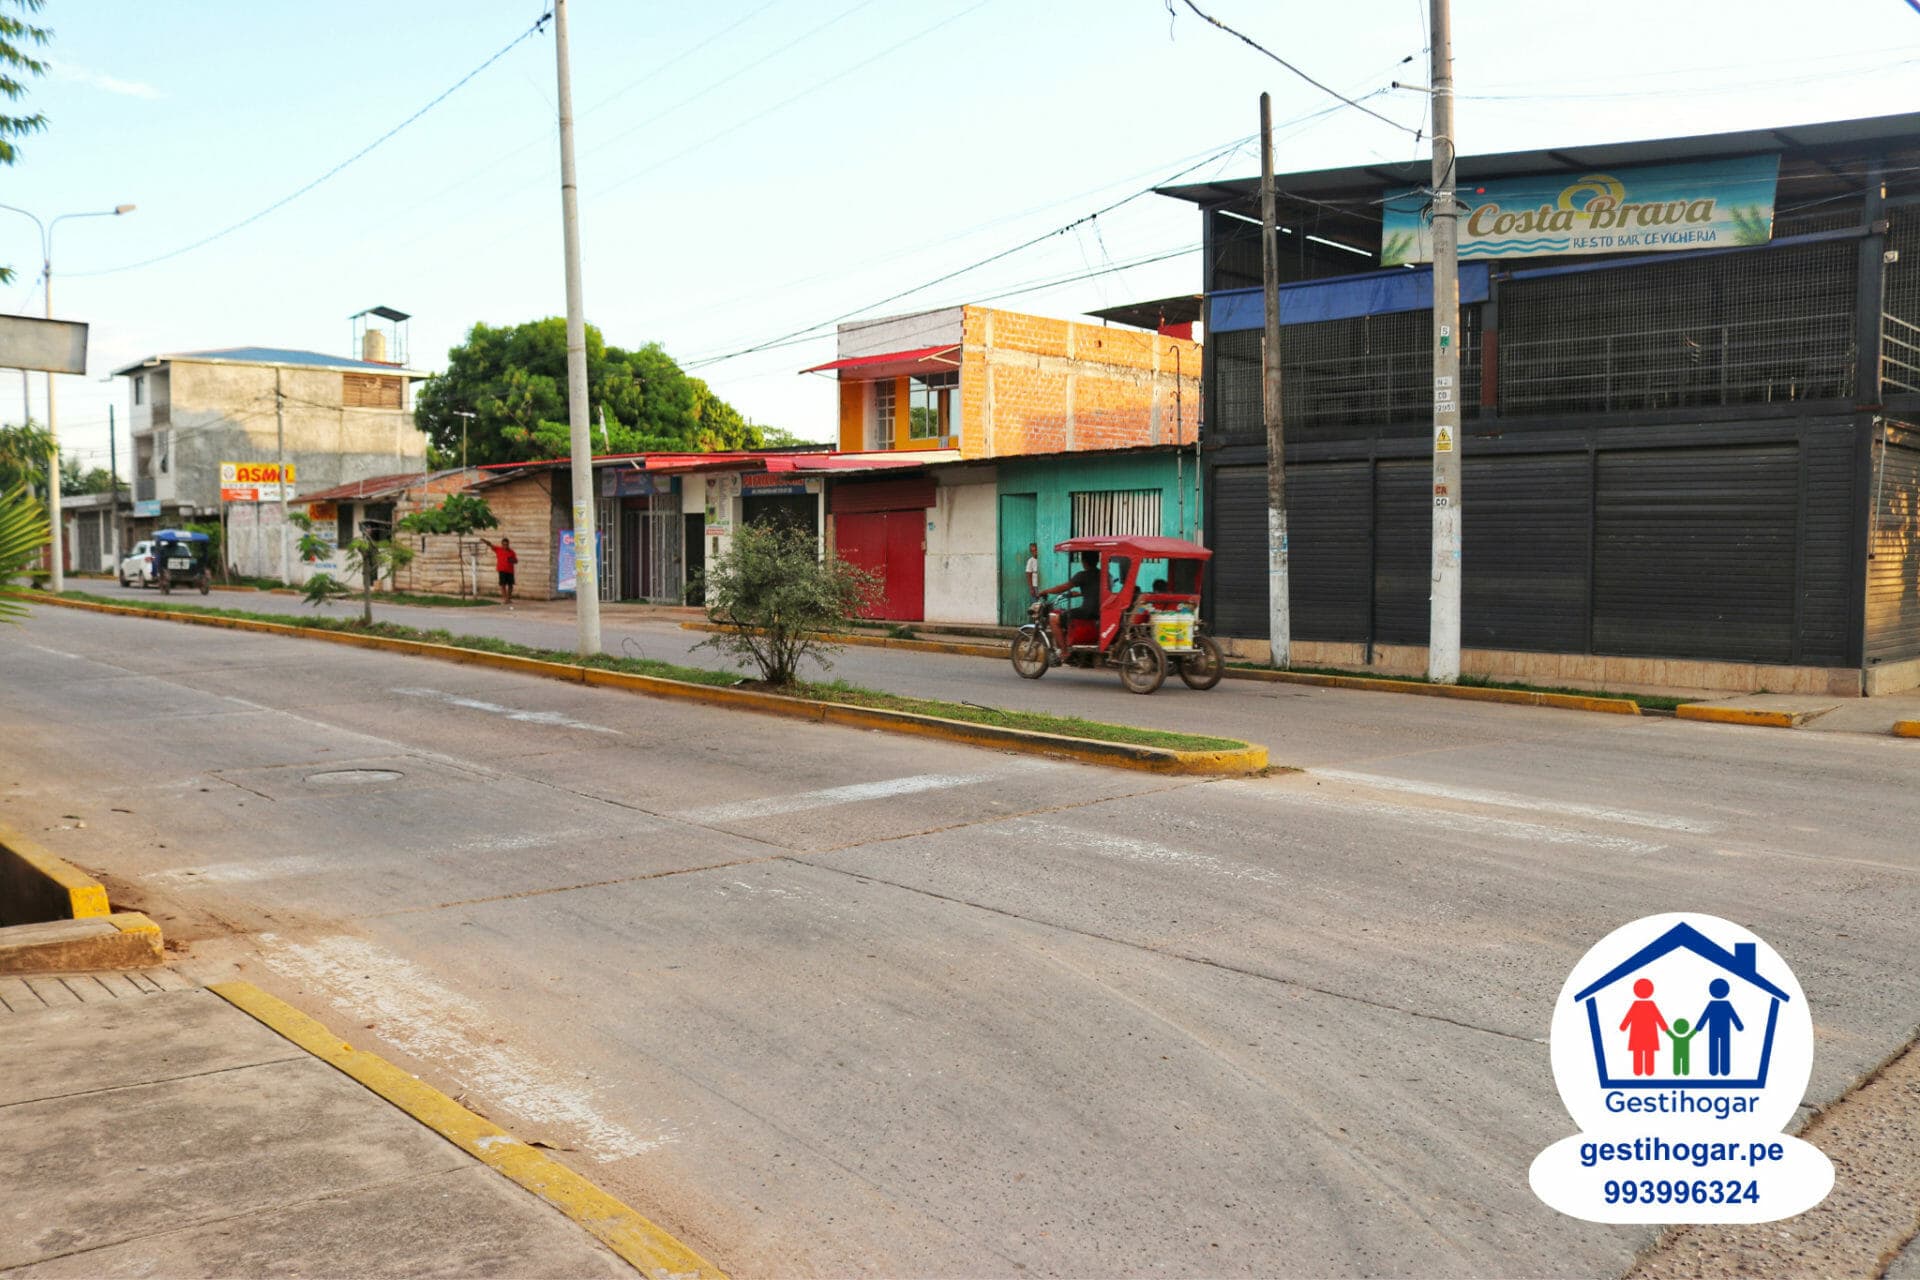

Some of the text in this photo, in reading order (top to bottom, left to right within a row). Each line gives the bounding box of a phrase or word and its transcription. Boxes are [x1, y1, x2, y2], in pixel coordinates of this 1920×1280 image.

[1467, 195, 1714, 237] Costa Brava
[1573, 230, 1716, 248] RESTO BAR CEVICHERIA
